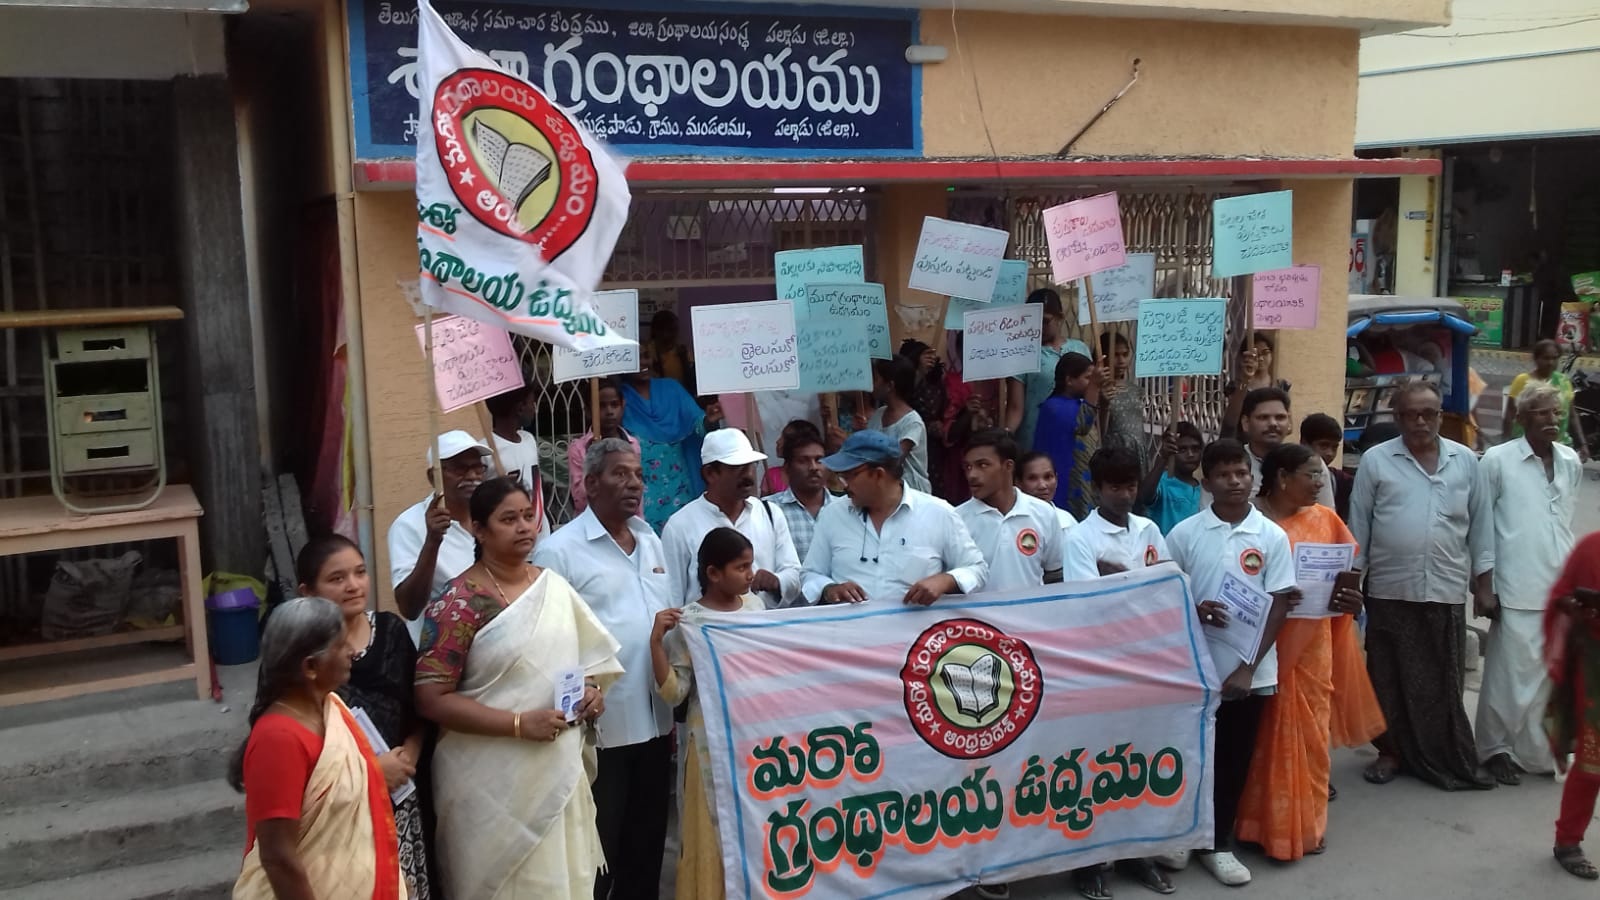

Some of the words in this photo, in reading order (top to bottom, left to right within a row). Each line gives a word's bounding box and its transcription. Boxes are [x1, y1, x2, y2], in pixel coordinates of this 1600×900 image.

[544, 36, 881, 117] గ్రంథాలయము
[751, 722, 882, 796] మరో
[764, 767, 1004, 895] గ్రంథాలయ
[1013, 742, 1186, 834] ఉద్యమం
